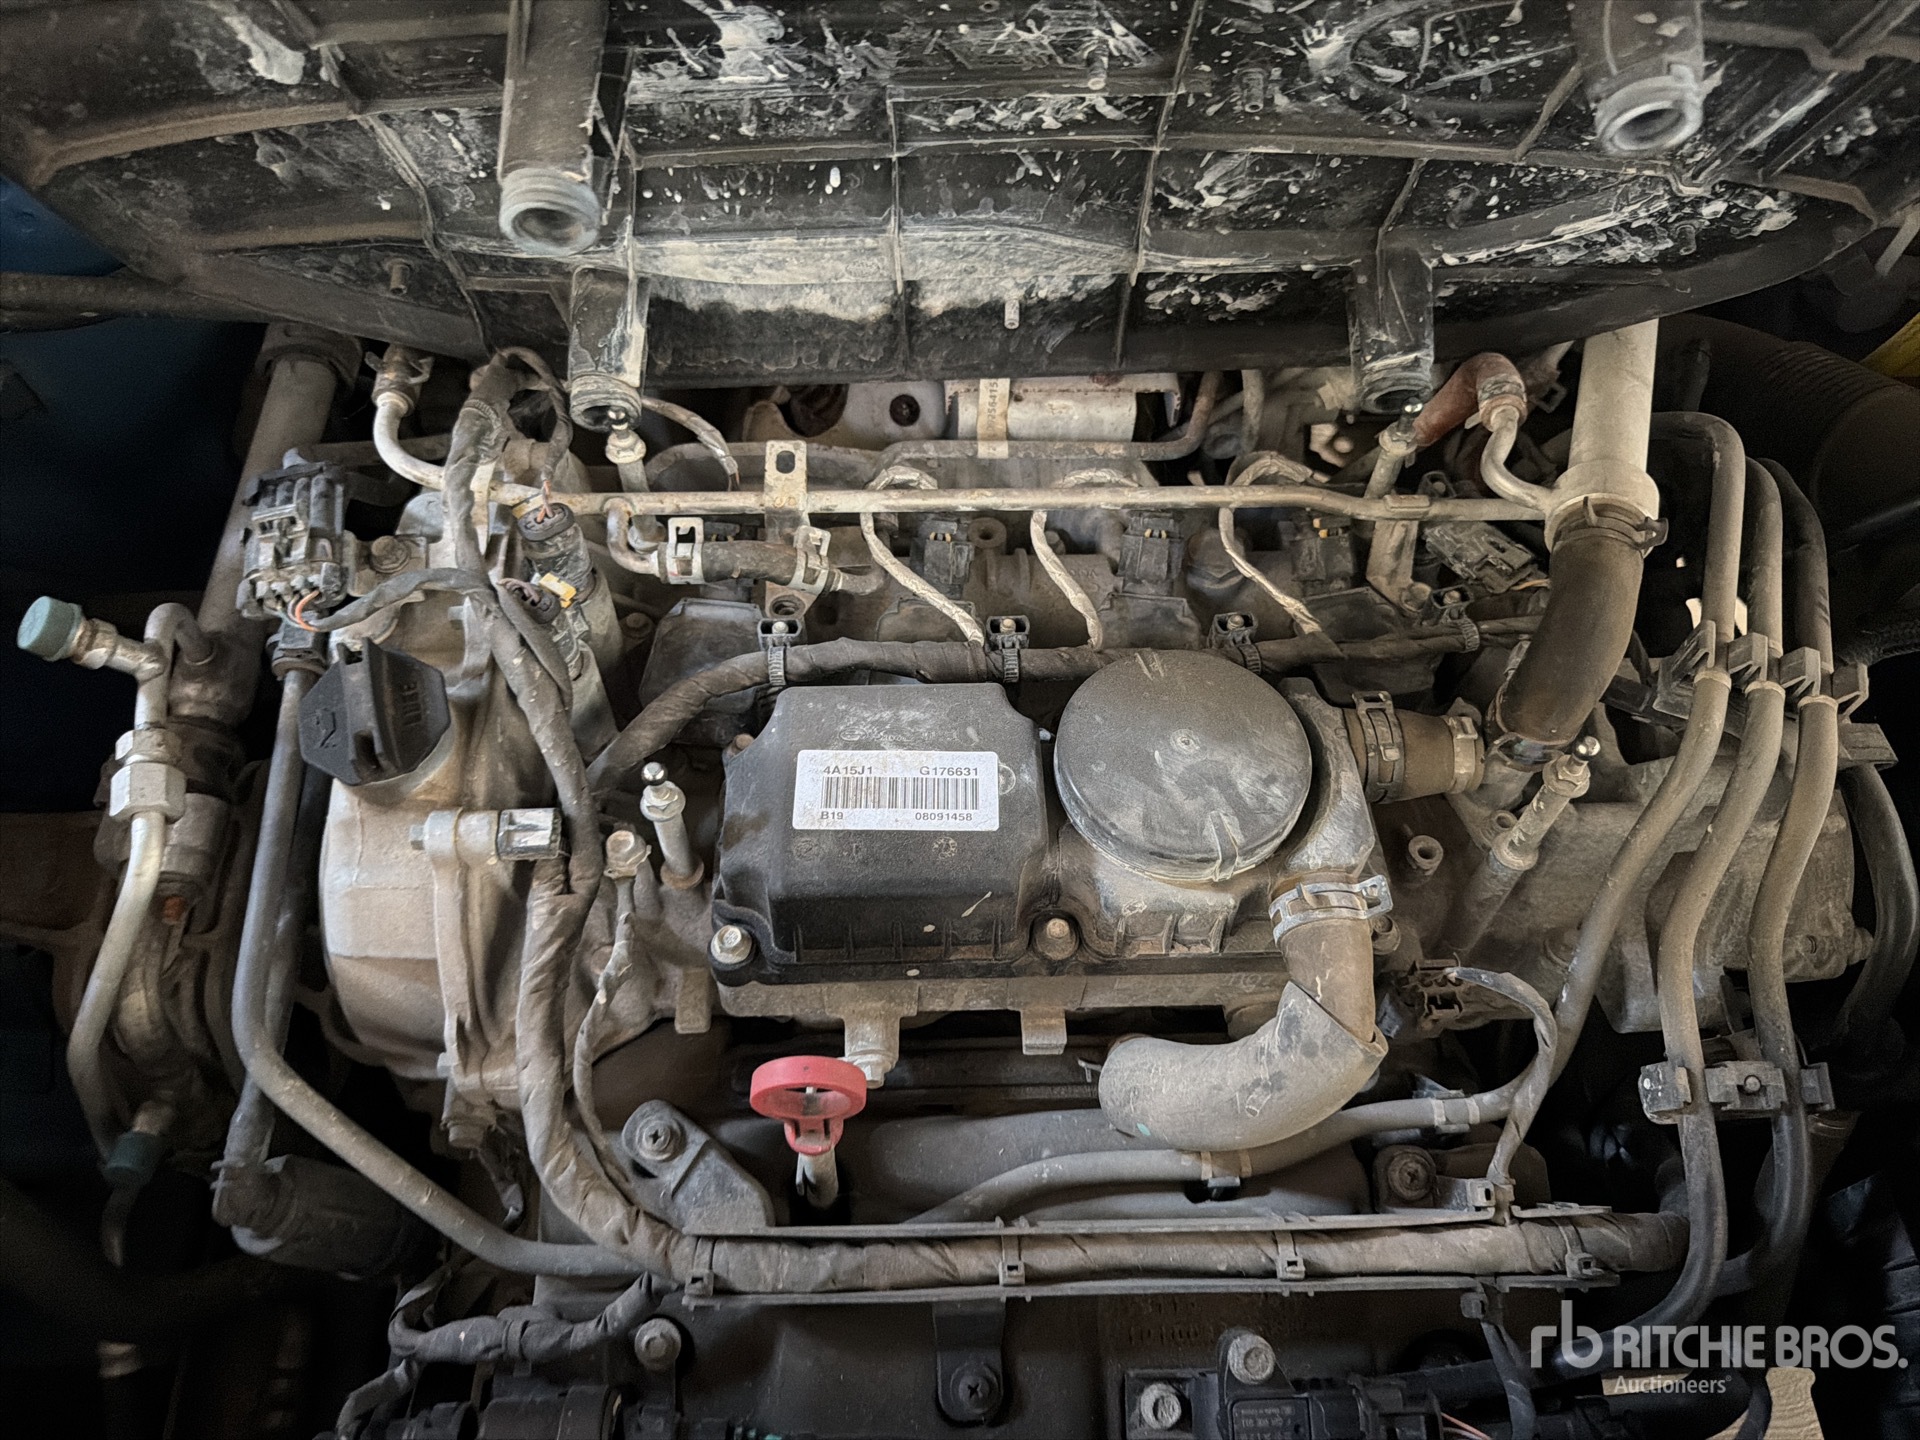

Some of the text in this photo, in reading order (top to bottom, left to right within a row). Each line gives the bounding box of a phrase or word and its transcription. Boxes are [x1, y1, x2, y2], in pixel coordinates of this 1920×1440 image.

[822, 766, 873, 776] 4A15J1
[919, 766, 979, 776] G176631
[820, 811, 844, 821] B19
[914, 812, 973, 822] 08091458
